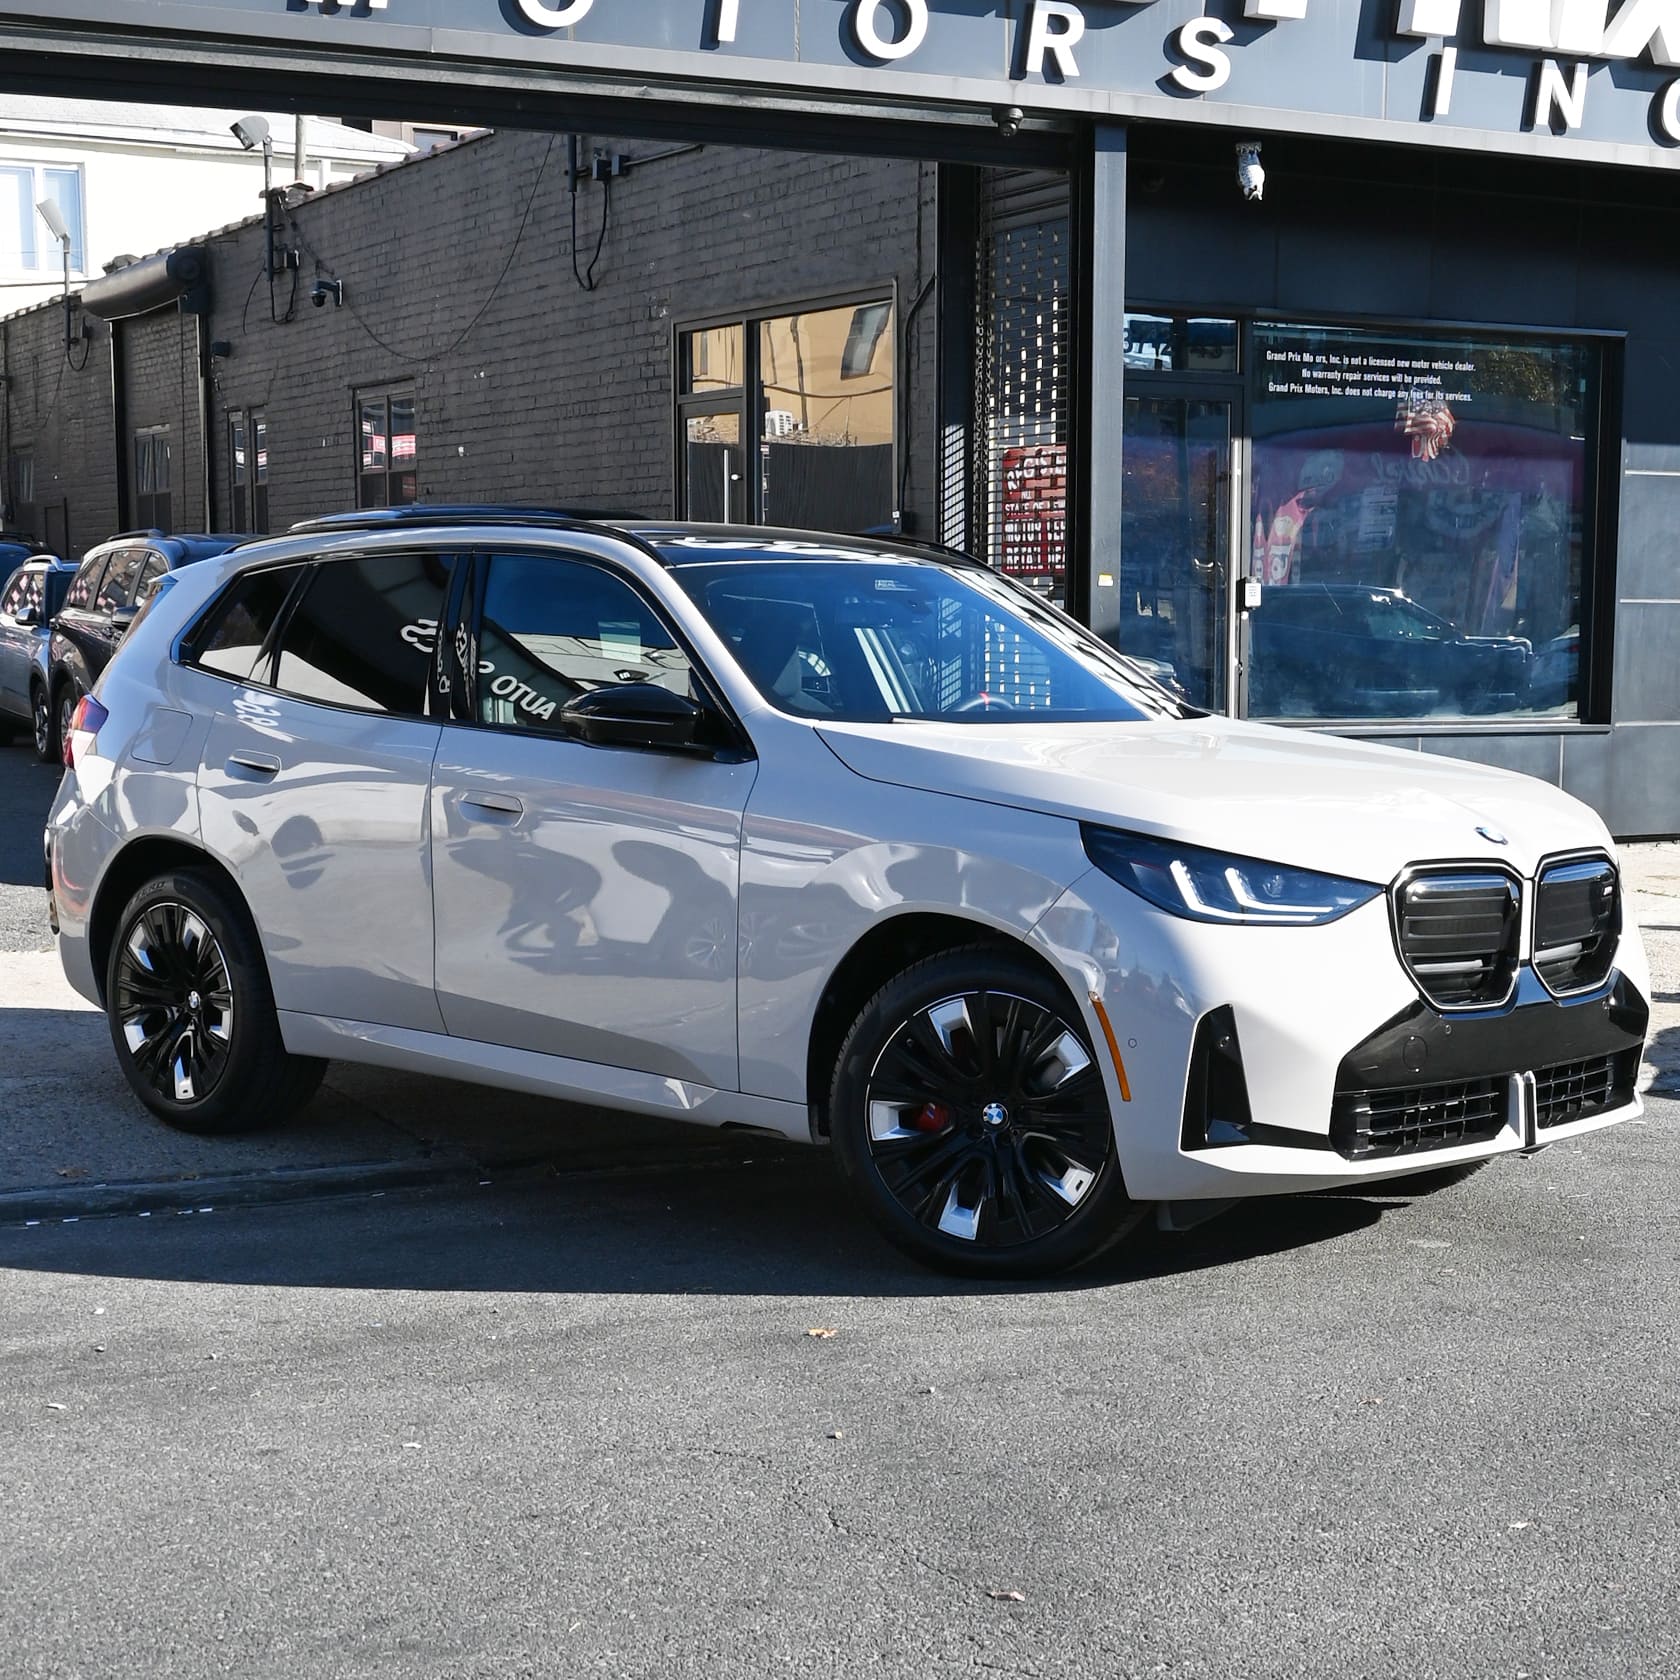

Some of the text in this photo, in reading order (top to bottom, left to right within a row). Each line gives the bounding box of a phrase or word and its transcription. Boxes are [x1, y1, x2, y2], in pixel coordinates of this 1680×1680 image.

[305, 0, 1235, 93] ORS
[1266, 350, 1476, 372] Grand Prix Moors, Inc. is not a licensed new motor vehicle dealer.
[1301, 368, 1442, 385] No warranty repair services will be provided.
[1268, 382, 1289, 393] Grand
[1289, 383, 1304, 393] Prix
[1304, 384, 1330, 395] Motors,
[1331, 385, 1344, 395] Inc.
[1345, 386, 1360, 396] does
[1361, 387, 1373, 397] not
[1374, 388, 1396, 399] charge
[1397, 390, 1409, 400] any
[1424, 390, 1434, 400] for
[1445, 392, 1472, 402] services.
